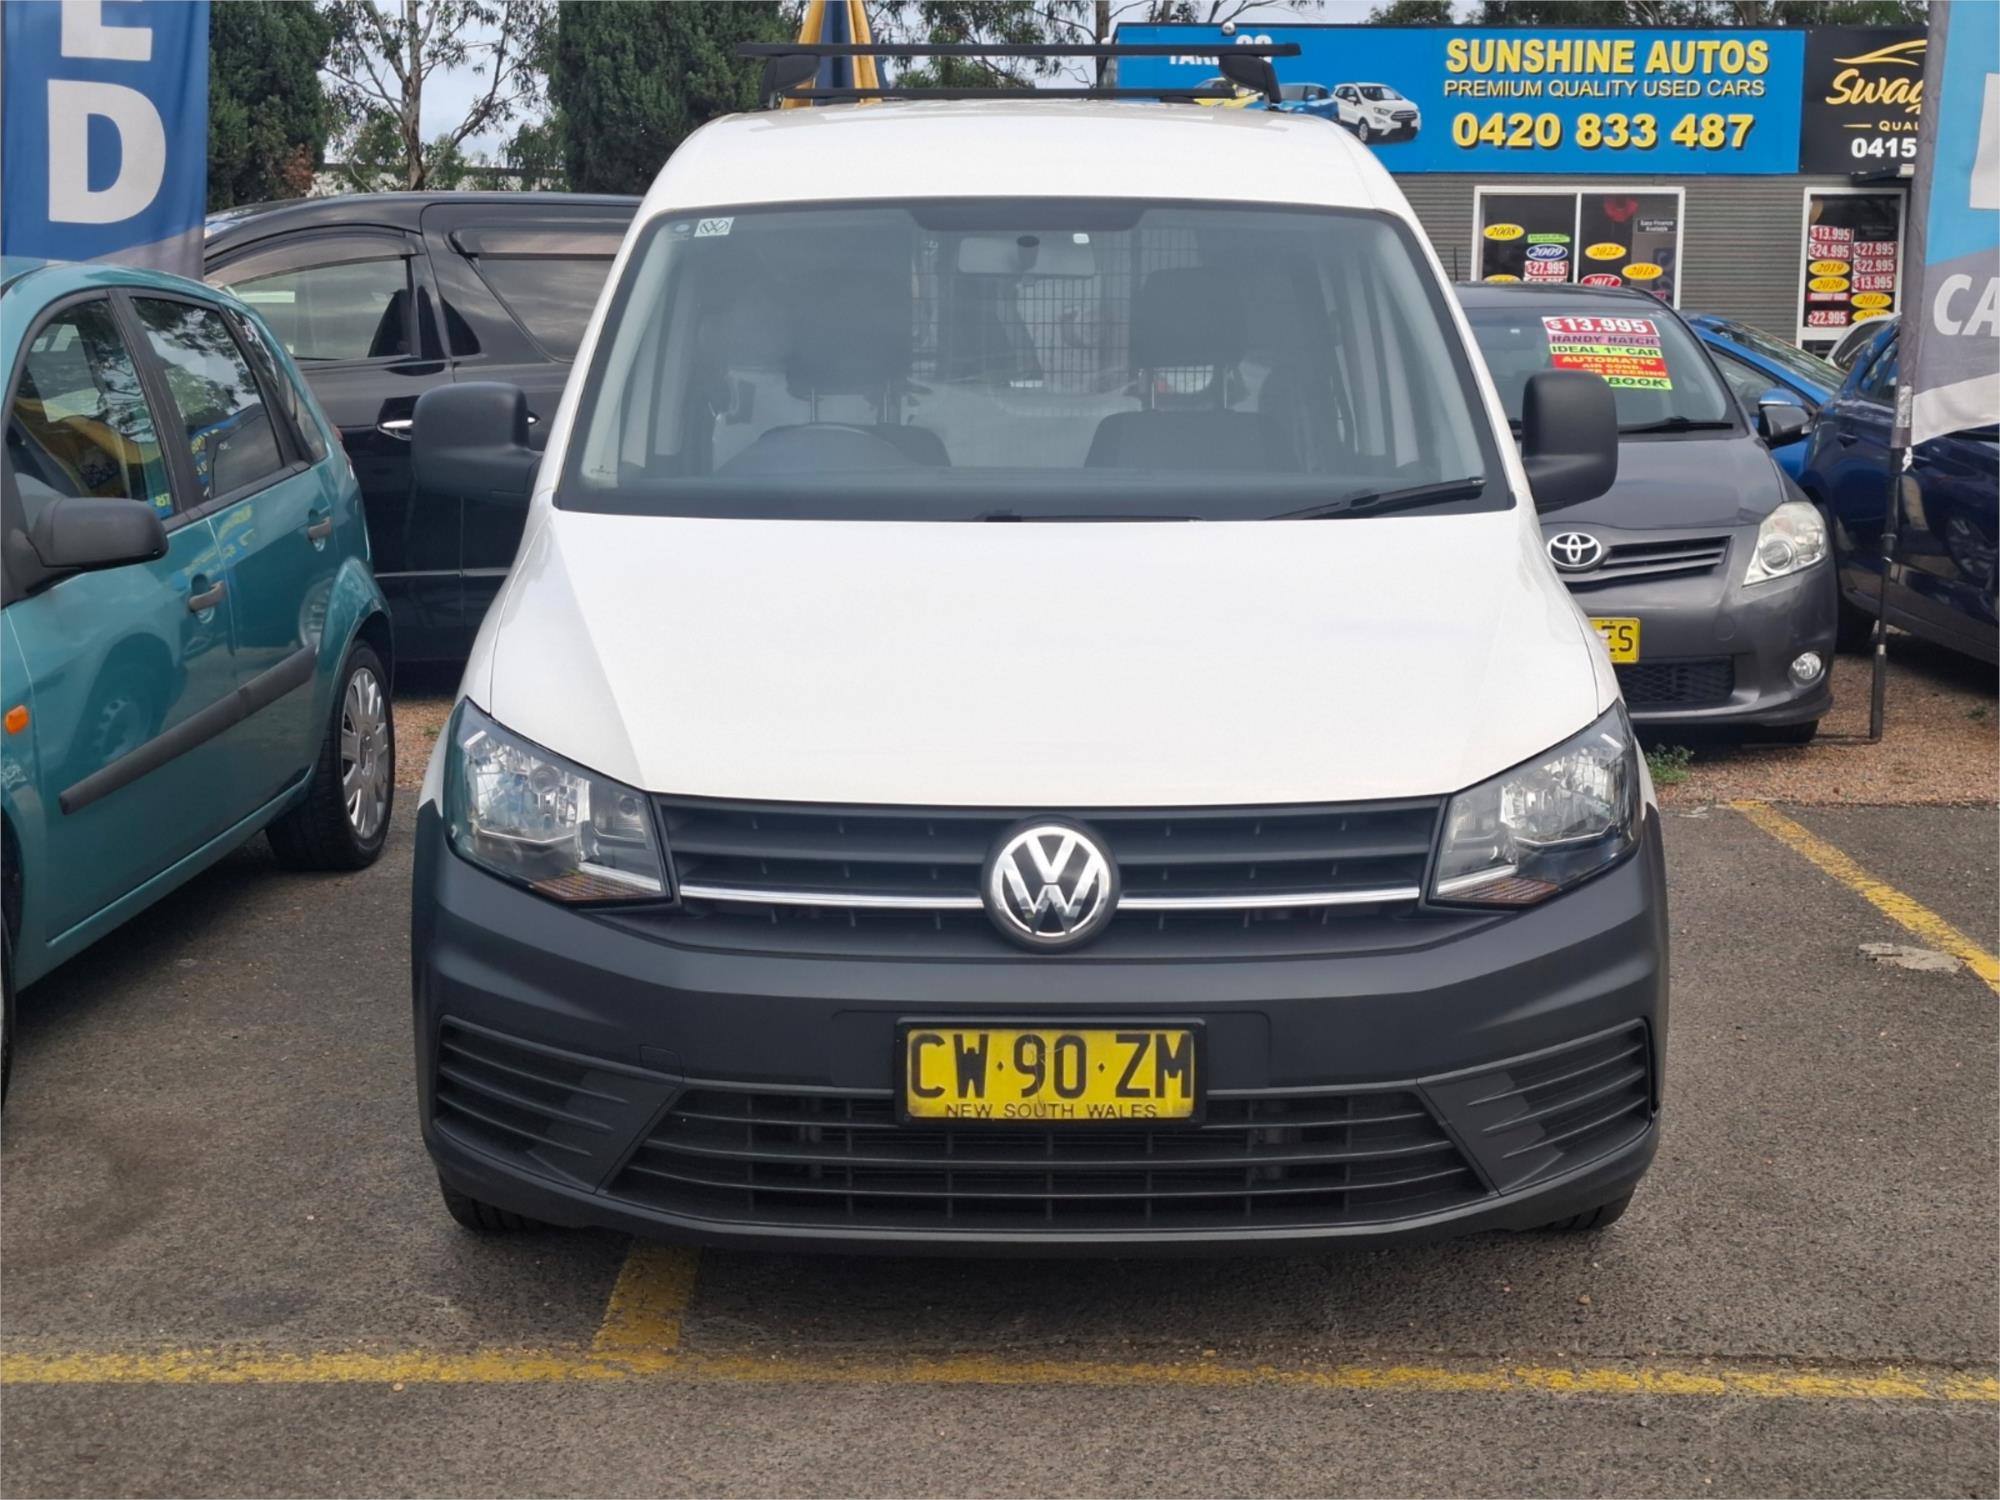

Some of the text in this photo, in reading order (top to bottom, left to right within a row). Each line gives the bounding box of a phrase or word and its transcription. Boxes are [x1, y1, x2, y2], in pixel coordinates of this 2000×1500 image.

[1446, 38, 1770, 75] SUNSHINE AUTOS
[1444, 79, 1766, 97] PREMIUM QUALITY USED CARS
[1452, 112, 1754, 148] 0420 833 487
[1851, 137, 1917, 158] 0415
[1551, 335, 1656, 345] HANDY HATCH
[1552, 345, 1600, 354] IDEAL
[1626, 347, 1659, 357] CAR
[1562, 355, 1657, 366] AUTOMATIC
[1608, 377, 1665, 387] BOOK
[945, 1103, 1157, 1118] NEW SOUTH WALES
